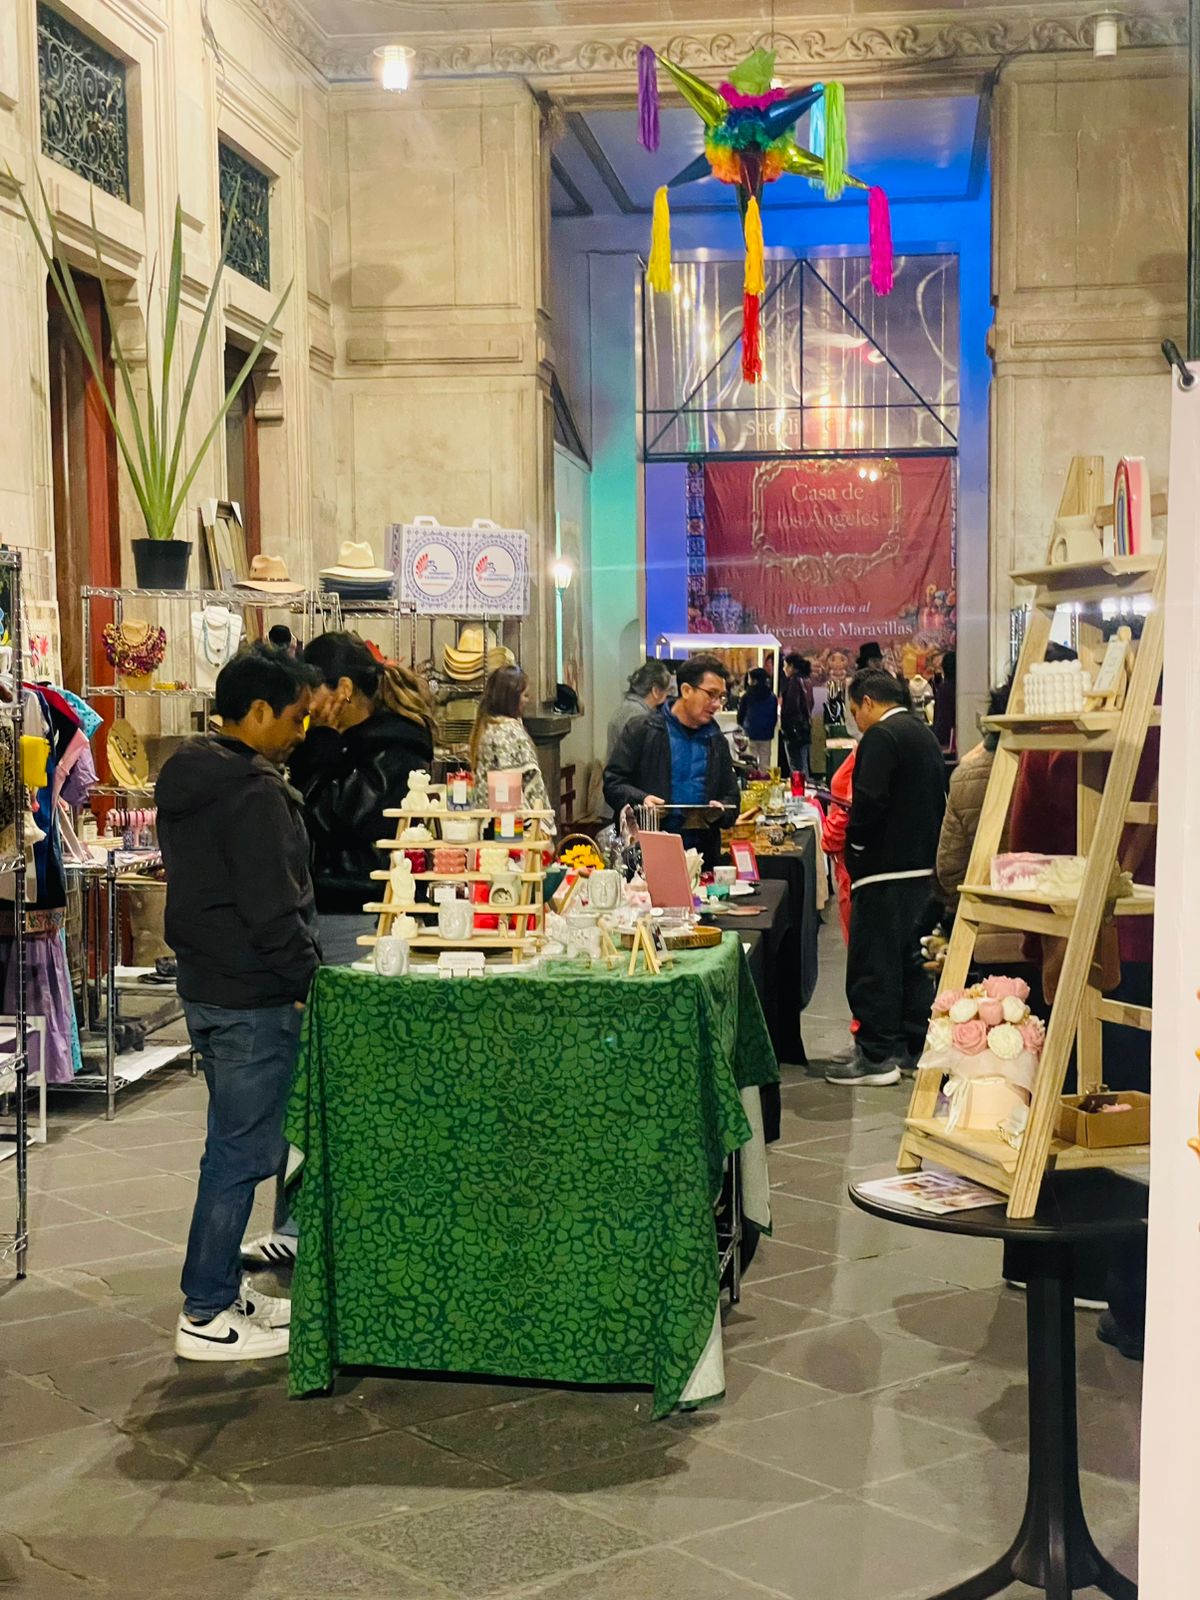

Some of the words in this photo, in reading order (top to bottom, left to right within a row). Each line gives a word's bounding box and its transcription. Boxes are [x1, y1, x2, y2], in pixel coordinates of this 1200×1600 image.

[791, 483, 838, 503] Casa
[841, 482, 864, 501] de
[787, 602, 855, 616] Bienvenidos
[858, 601, 871, 614] al
[753, 623, 814, 639] Mercado
[818, 623, 835, 638] de
[839, 621, 913, 638] Maravillas
